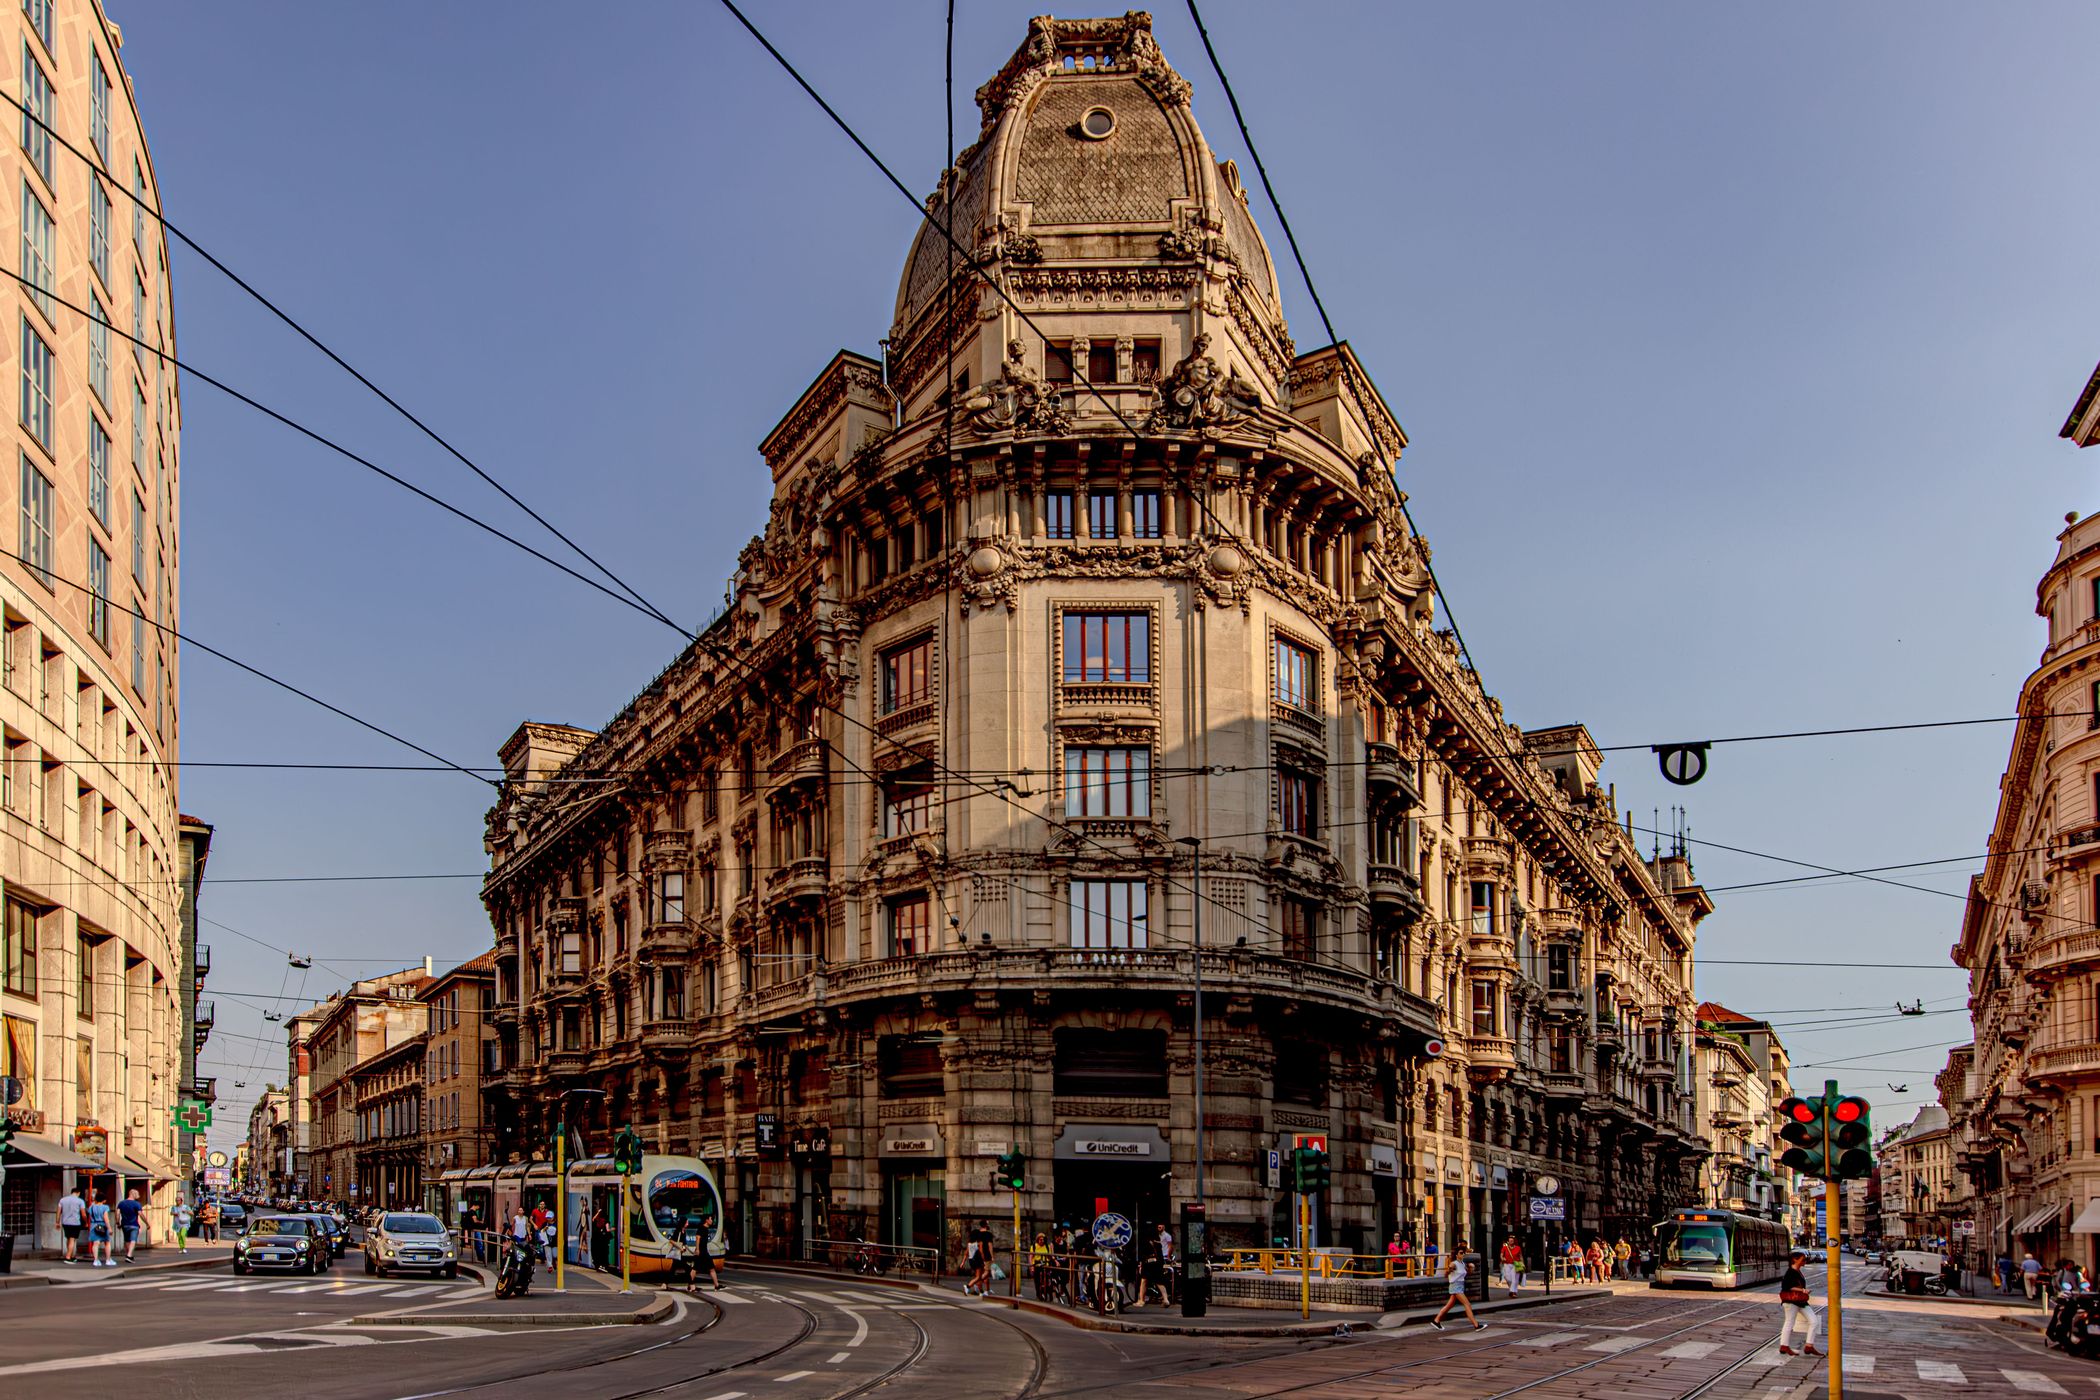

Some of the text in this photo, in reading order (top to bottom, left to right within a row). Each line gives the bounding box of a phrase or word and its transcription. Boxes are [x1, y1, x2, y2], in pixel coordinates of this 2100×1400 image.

[758, 1114, 775, 1122] BAR
[759, 1125, 774, 1141] T
[793, 1139, 809, 1153] Time
[1098, 1143, 1138, 1153] UniCredit
